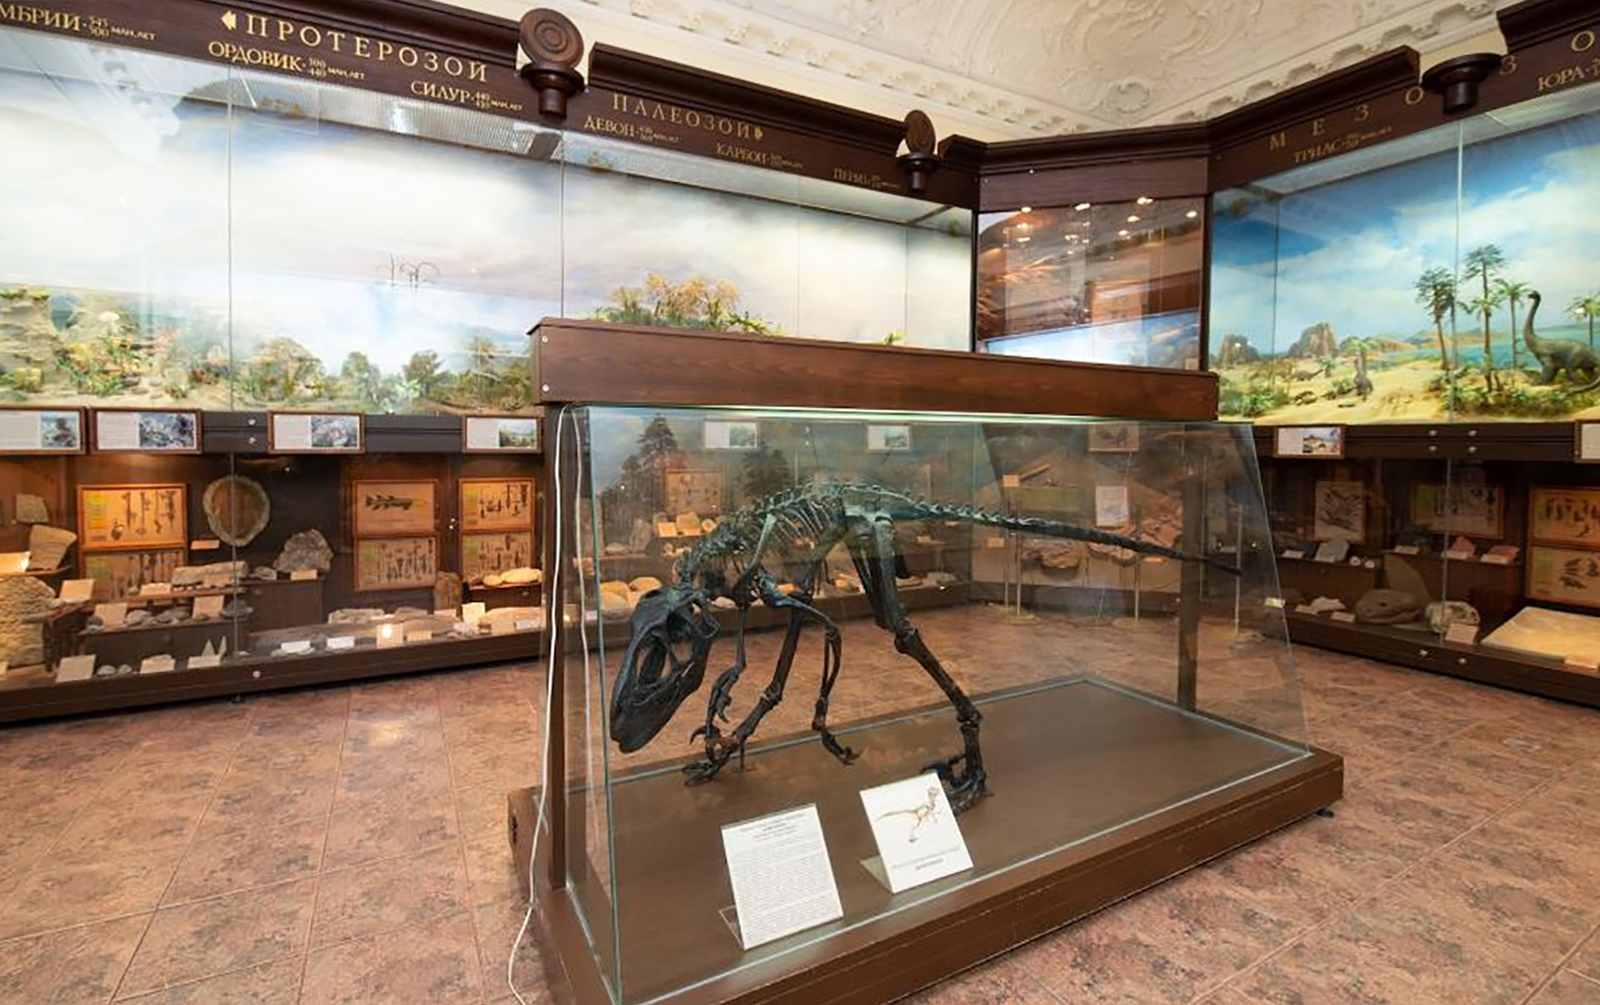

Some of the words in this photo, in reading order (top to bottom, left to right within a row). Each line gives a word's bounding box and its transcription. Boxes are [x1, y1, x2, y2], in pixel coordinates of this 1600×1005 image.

[208, 41, 302, 71] ОРДОВИК
[245, 12, 487, 82] ПРОТЕРОЗОЙ
[411, 80, 471, 102] СИЛУР
[1537, 66, 1585, 91] ЮРА
[584, 115, 635, 137] ДЕВОН
[613, 92, 750, 139] ПАЛЕОЗОЙ
[716, 142, 767, 165] КАРБОН
